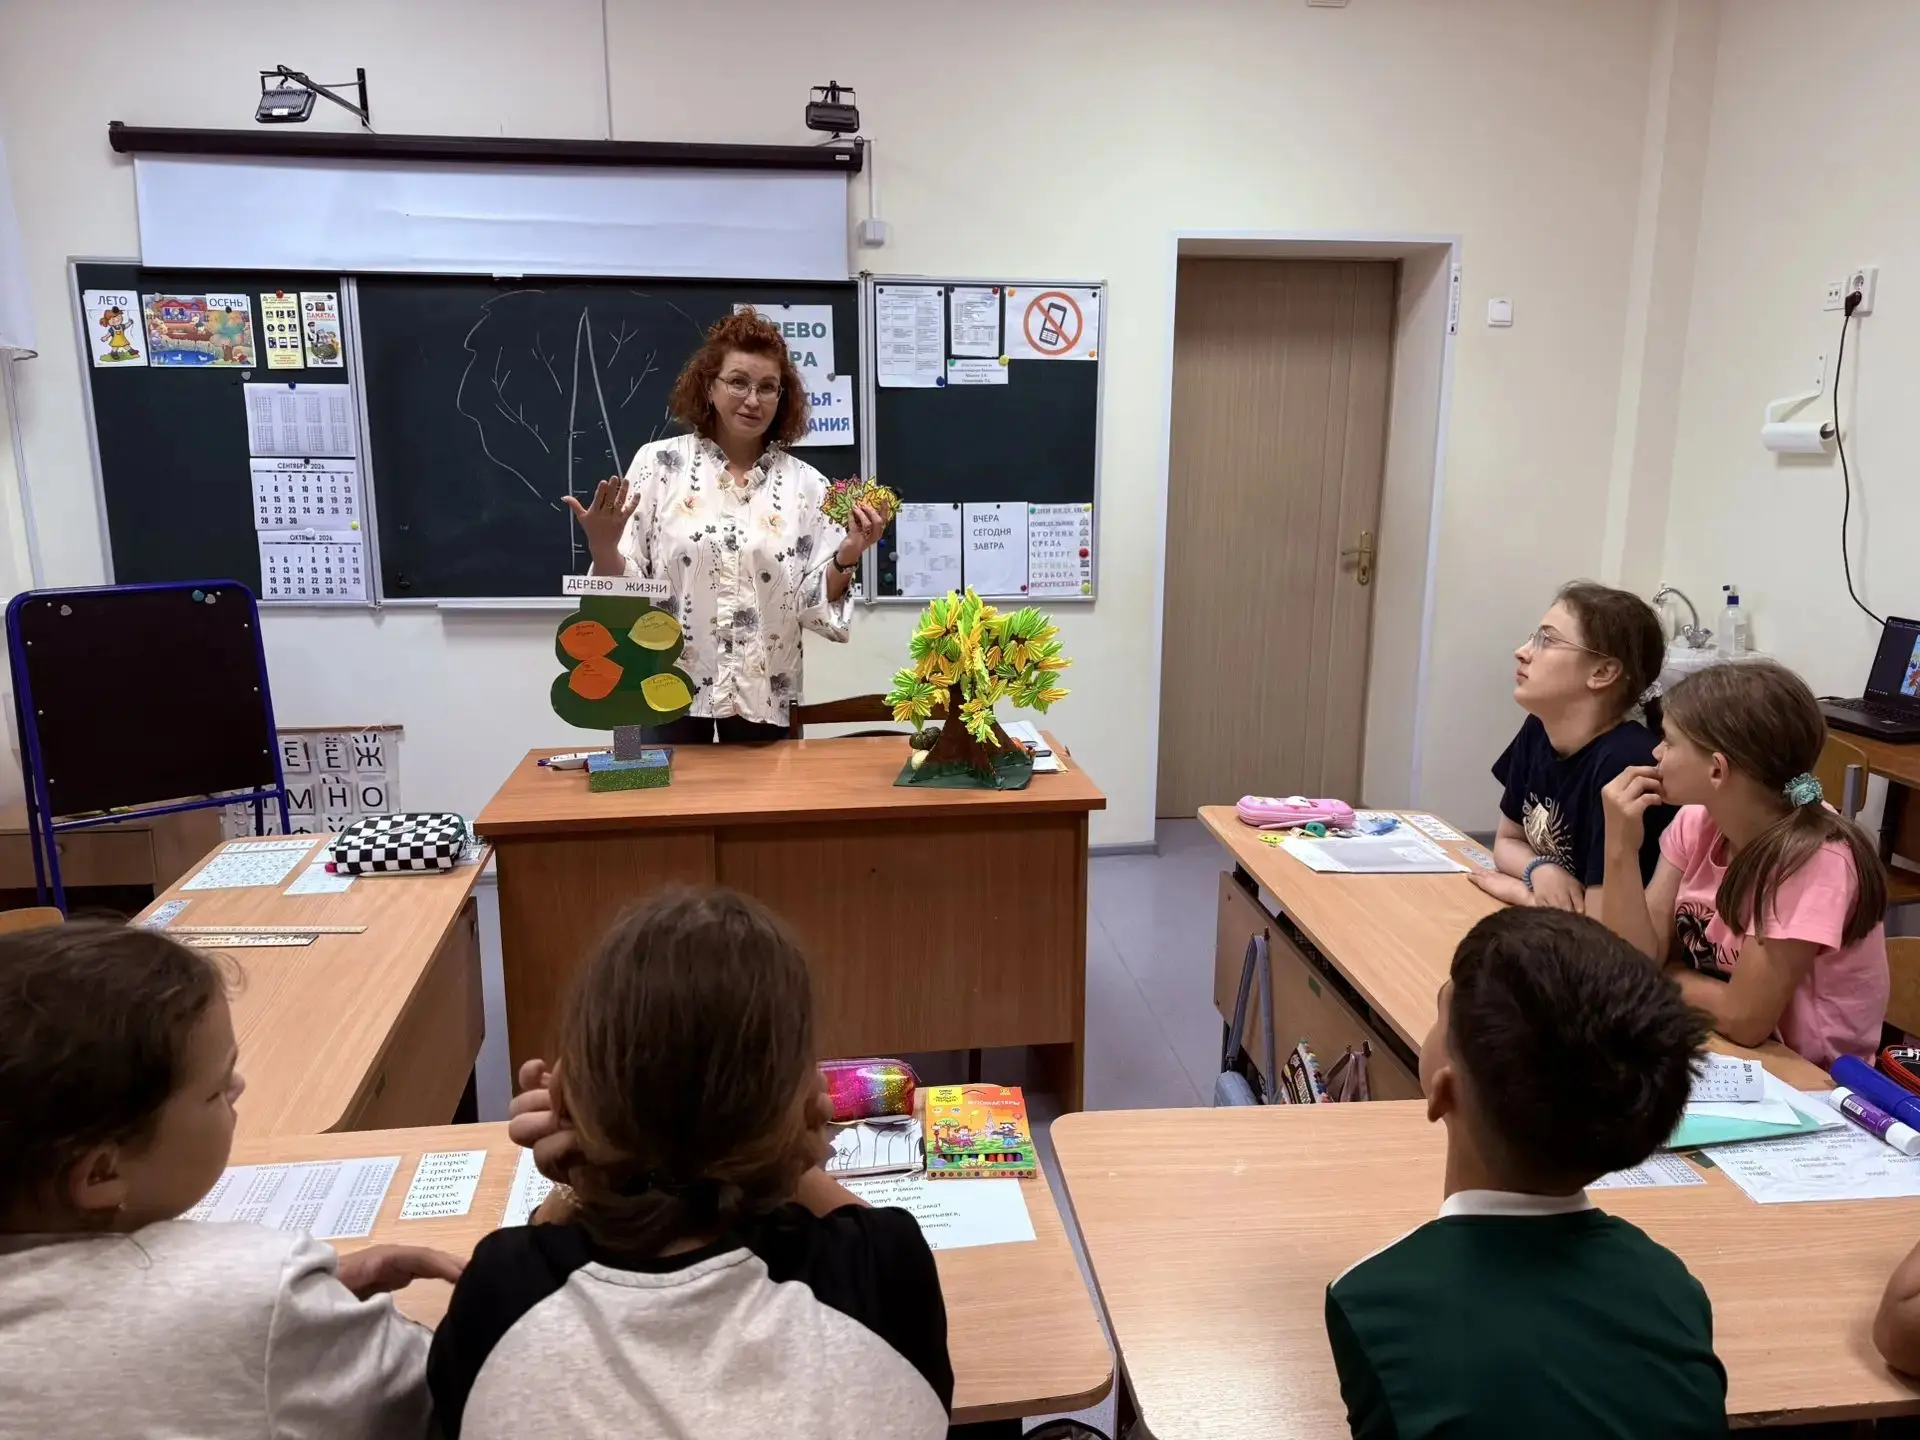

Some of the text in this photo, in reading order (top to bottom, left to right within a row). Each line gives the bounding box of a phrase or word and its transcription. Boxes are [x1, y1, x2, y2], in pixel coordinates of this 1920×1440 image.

[98, 296, 127, 305] ЛЕТО
[209, 298, 243, 308] ОСЕНЬ
[790, 351, 818, 367] РА
[808, 418, 850, 432] АНИЯ
[973, 514, 1000, 522] ВЧЕРА
[974, 528, 1012, 536] СЕГОДНЯ
[974, 542, 1004, 550] ЗАВТРА
[567, 578, 667, 594] ДЕРЕВО ЖИЗНИ
[286, 788, 313, 809] М
[328, 787, 347, 808] Н
[362, 786, 384, 807] О
[864, 1178, 906, 1186] рождения
